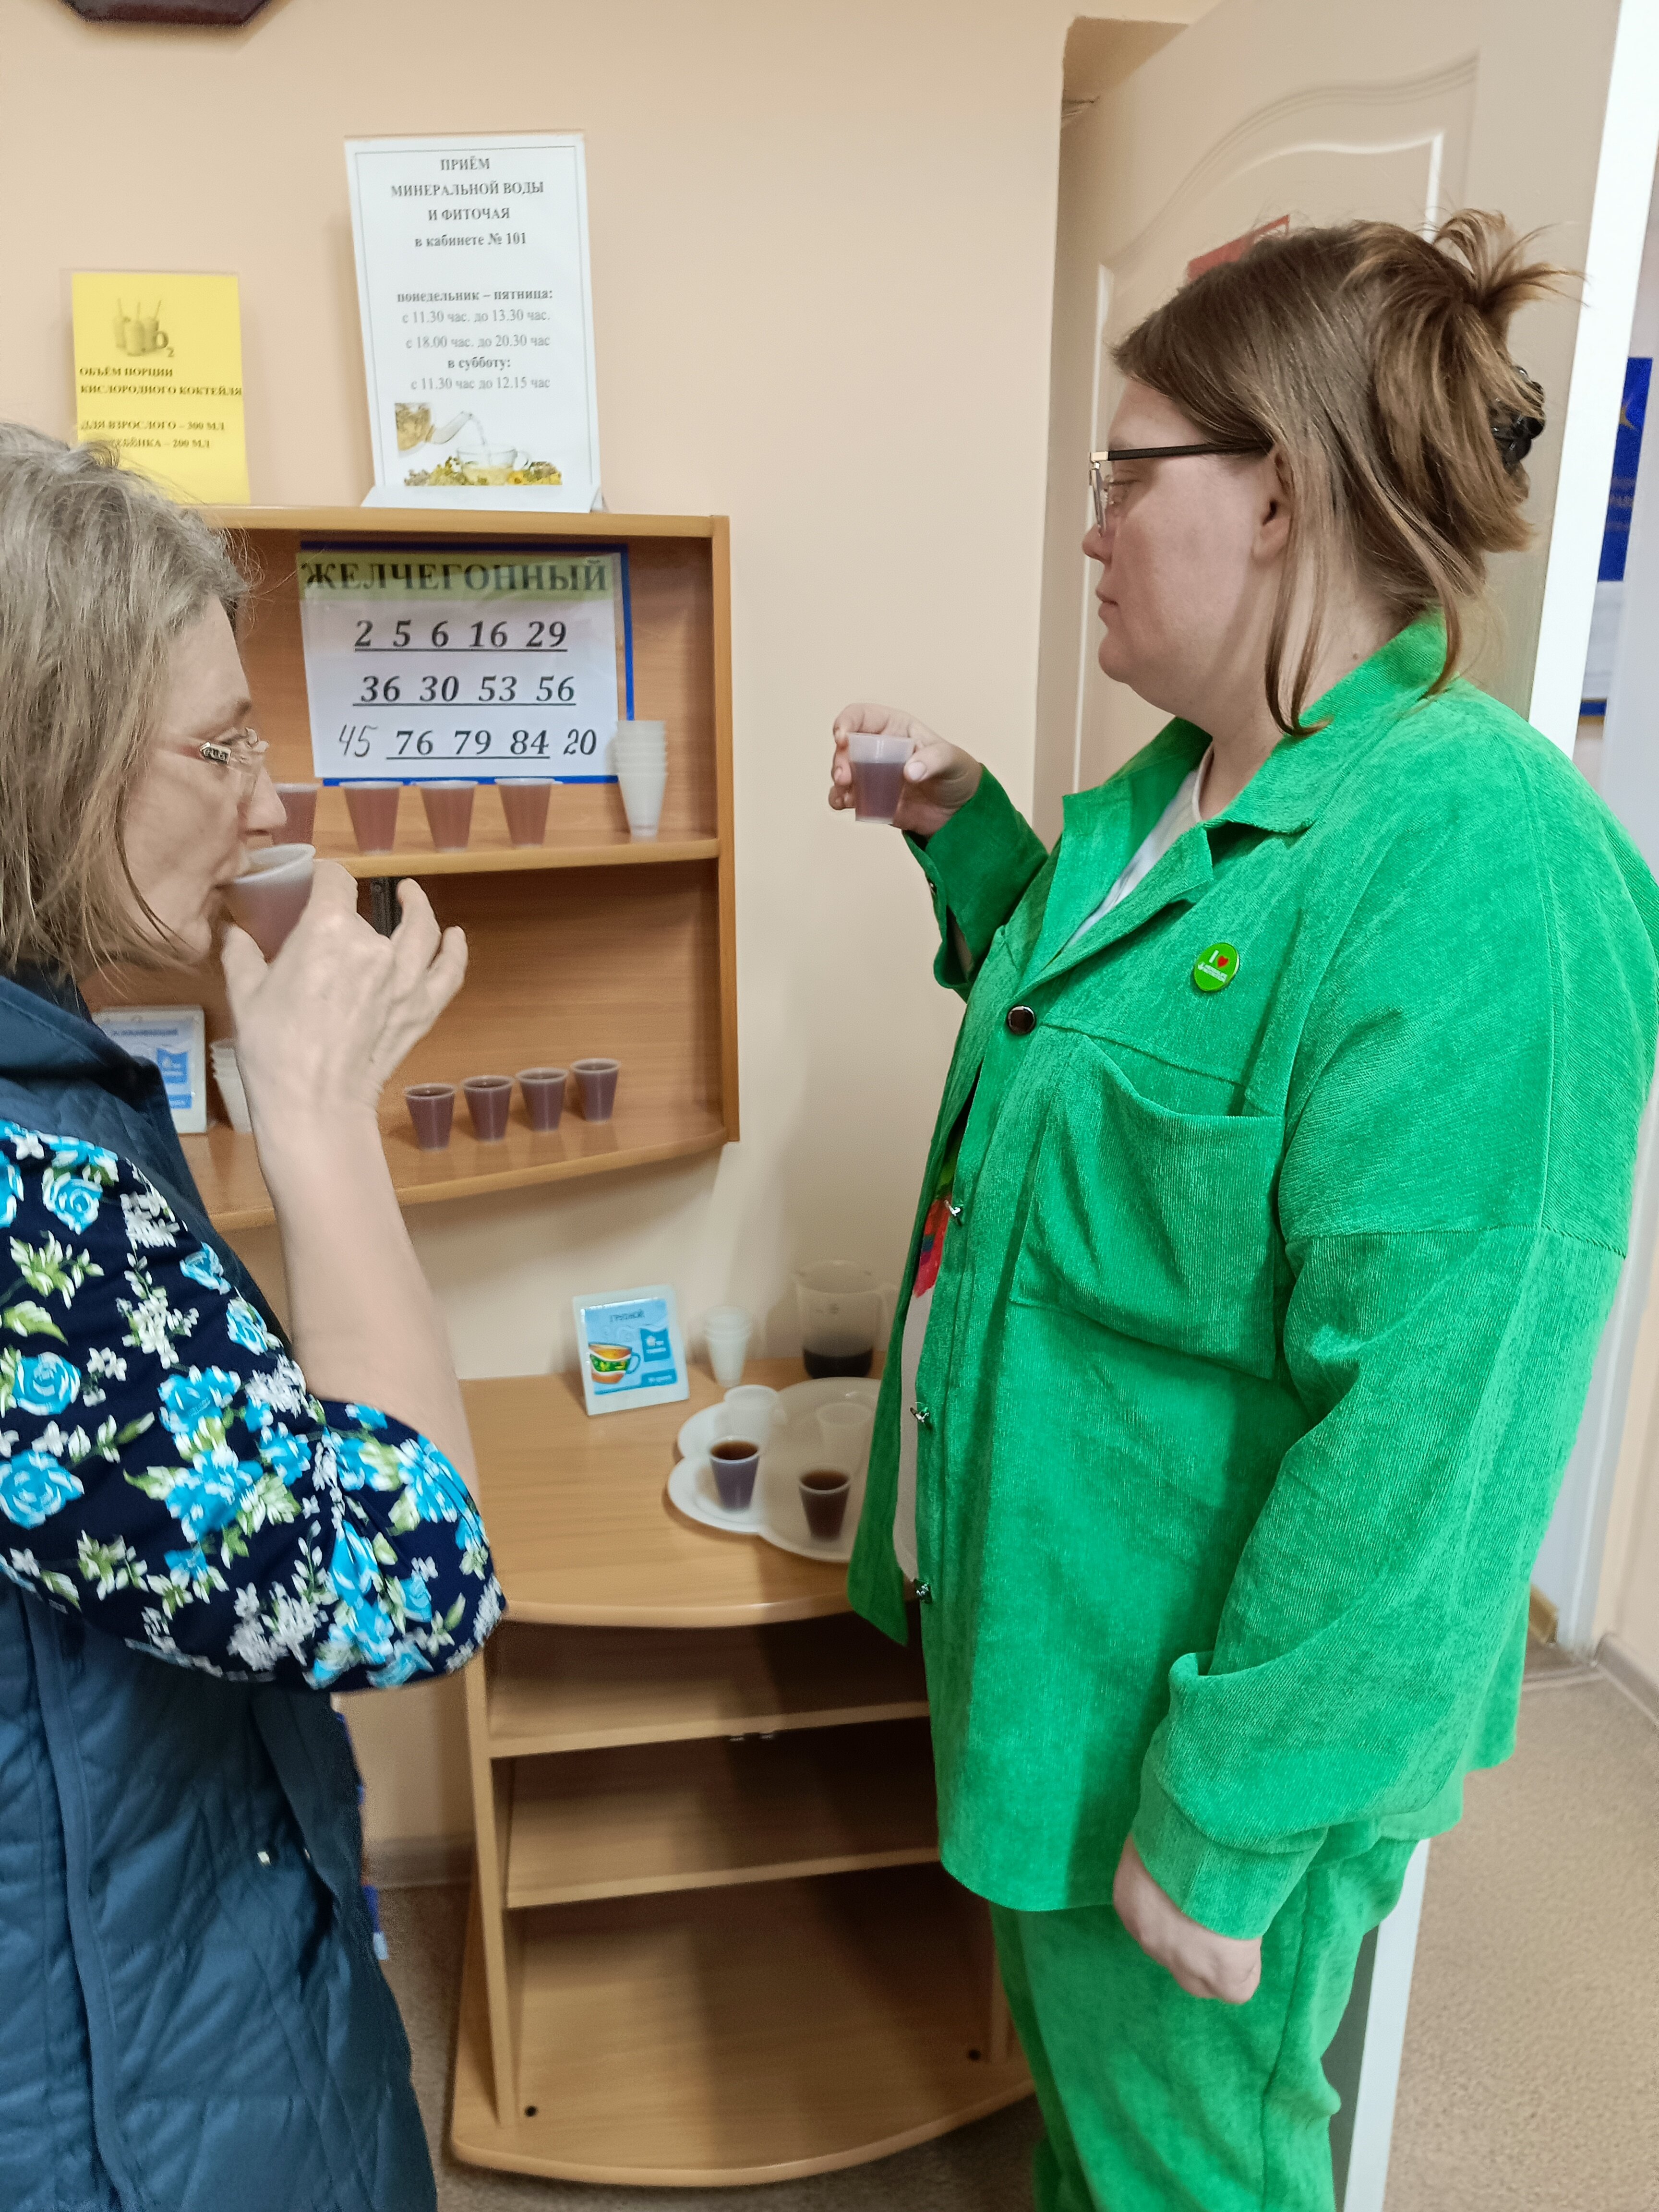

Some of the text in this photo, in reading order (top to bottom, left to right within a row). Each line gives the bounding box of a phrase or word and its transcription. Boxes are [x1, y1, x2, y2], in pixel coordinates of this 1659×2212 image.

[440, 156, 491, 171] ПРИЁМ
[391, 180, 544, 197] МИНЕРАЛЬНОЙ ВОДЫ
[428, 207, 510, 221] И ФИТОЧАЯ
[415, 232, 526, 247] в кабинете № 101
[397, 292, 480, 302] понедельник
[413, 311, 444, 323] 11.30
[474, 312, 488, 324] до
[493, 309, 523, 321] 13.30
[417, 336, 447, 349] 18.00
[478, 337, 492, 348] до
[495, 335, 527, 348] 20.30
[530, 336, 550, 346] час
[448, 357, 510, 371] в субботу:
[125, 368, 172, 377] ПОРЦИИ
[422, 378, 452, 389] 11.30
[456, 379, 474, 388] час
[479, 379, 493, 388] до
[496, 377, 527, 388] 12.15
[530, 377, 550, 388] час
[81, 385, 242, 396] КИСЛОРОДНОГО КОКТЕЙЛЯ
[108, 421, 176, 430] ВЗРОСЛОГО
[207, 421, 225, 430] МЛ
[173, 439, 189, 448] 200
[192, 439, 210, 448] МЛ
[302, 560, 606, 591] ЖЕЛЧЕГОННЫЙ
[355, 620, 566, 648] 2 5 6 16 29
[361, 675, 575, 702] 36 30 53 56
[338, 723, 597, 757] 45 76 79 84 20
